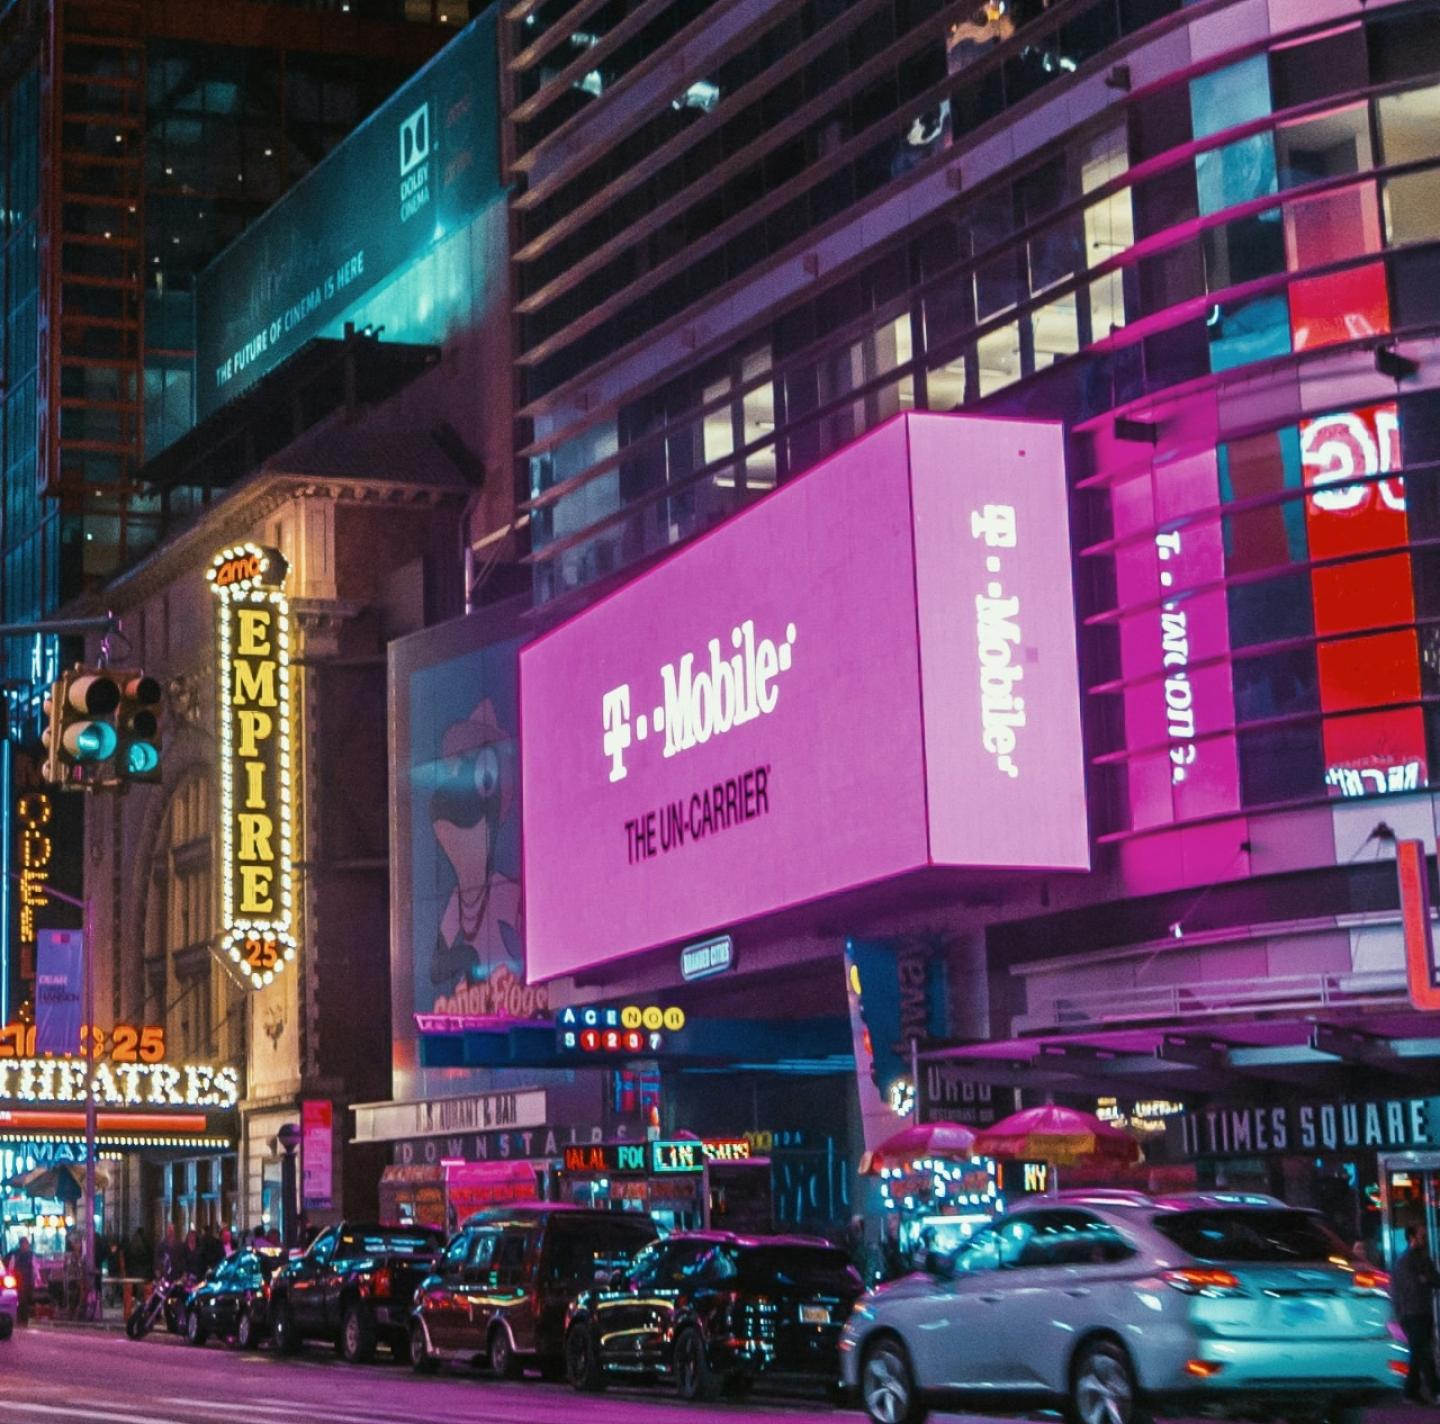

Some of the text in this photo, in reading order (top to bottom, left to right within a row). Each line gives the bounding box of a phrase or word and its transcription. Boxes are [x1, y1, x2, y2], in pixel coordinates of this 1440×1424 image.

[401, 161, 429, 201] DOLBY
[216, 356, 232, 387] THE
[234, 330, 267, 373] FUTURE
[270, 317, 282, 345] OF
[284, 286, 321, 332] CINEMA
[324, 275, 335, 300] IS
[336, 250, 364, 291] HERE
[233, 608, 278, 912] EMPIRE
[625, 768, 771, 865] THE UN-CARRIER
[246, 937, 278, 968] 25
[112, 1026, 166, 1063] 25
[1207, 1108, 1288, 1152] TIMES
[1299, 1100, 1428, 1150] SQUARE
[1024, 1164, 1047, 1192] NY
